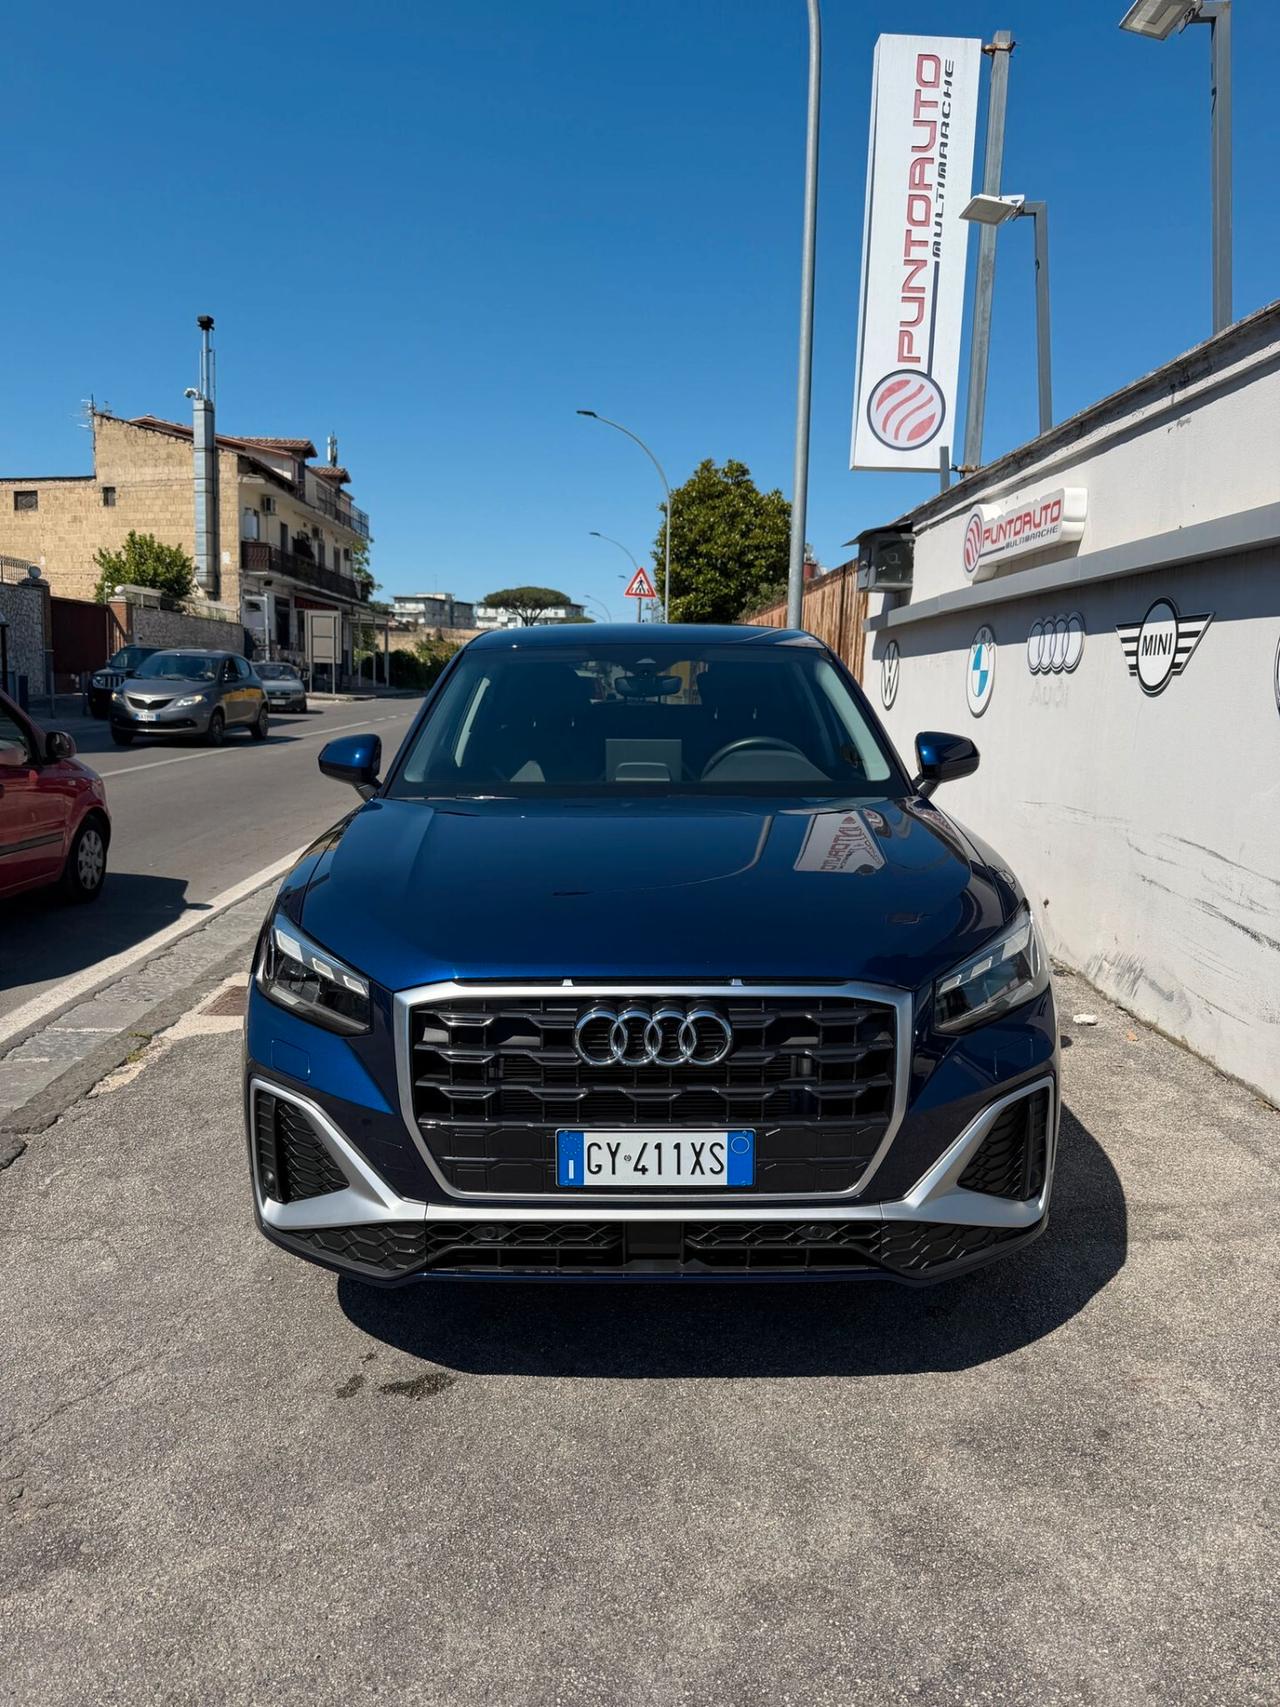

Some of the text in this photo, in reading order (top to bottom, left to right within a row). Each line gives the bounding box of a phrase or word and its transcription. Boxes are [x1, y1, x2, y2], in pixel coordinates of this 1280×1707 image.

[932, 58, 954, 258] MULTIMARCHE
[897, 53, 941, 363] PUNTOAUTO
[982, 499, 1061, 548] PUNTOAUTO
[1141, 632, 1173, 656] MINI
[586, 1142, 725, 1175] GY 411XS
